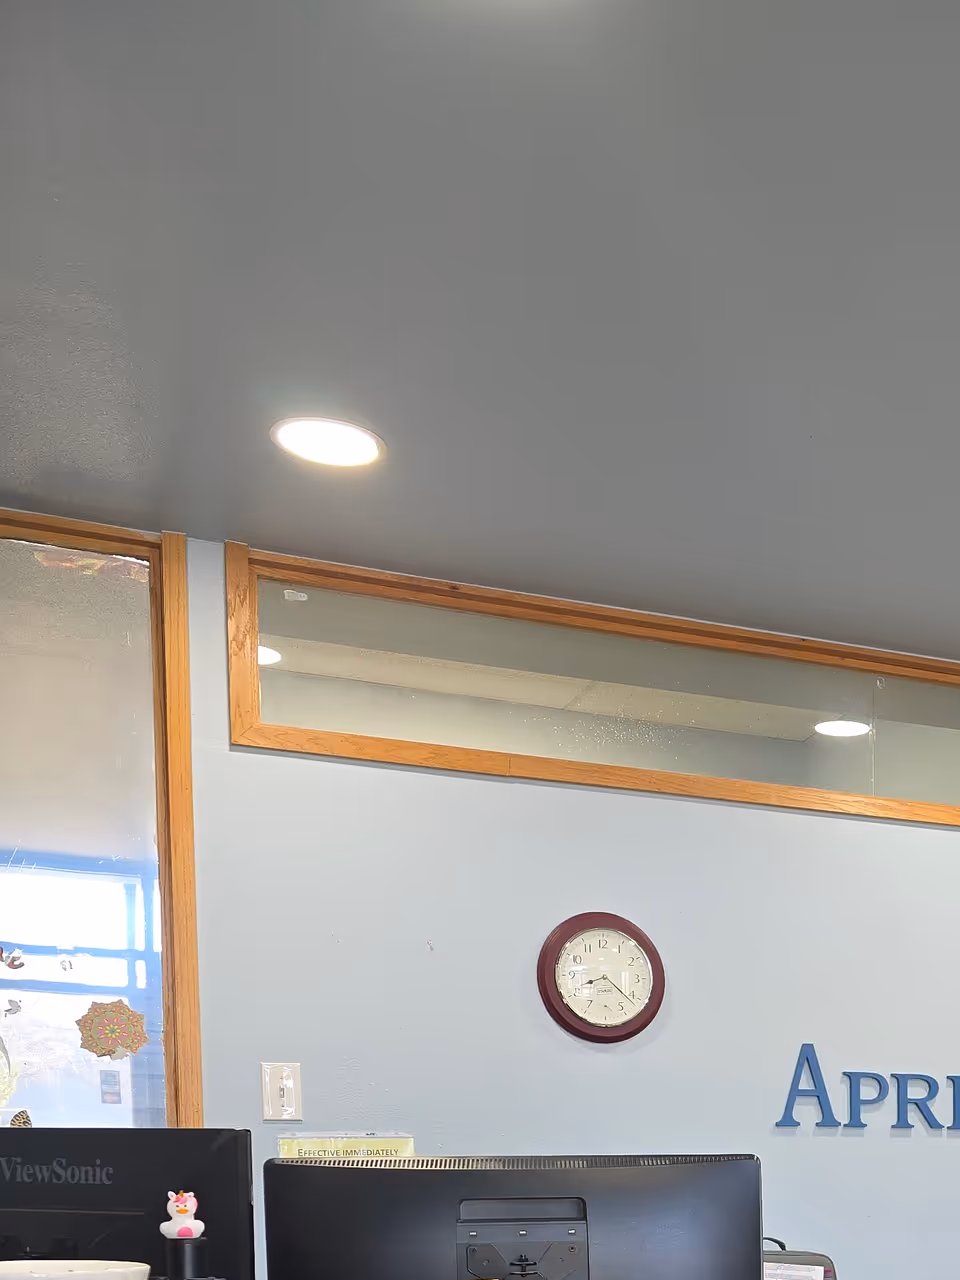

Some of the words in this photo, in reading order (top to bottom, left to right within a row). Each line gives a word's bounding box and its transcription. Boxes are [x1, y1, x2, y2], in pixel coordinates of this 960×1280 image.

[584, 943, 592, 953] 11
[598, 939, 608, 949] 12
[572, 955, 582, 964] 10
[628, 957, 635, 966] 2
[568, 970, 576, 979] 9
[634, 973, 640, 983] 3
[628, 990, 636, 999] 4
[586, 999, 593, 1009] 7
[617, 1001, 624, 1011] 5
[0, 1157, 113, 1185] ViewSonic
